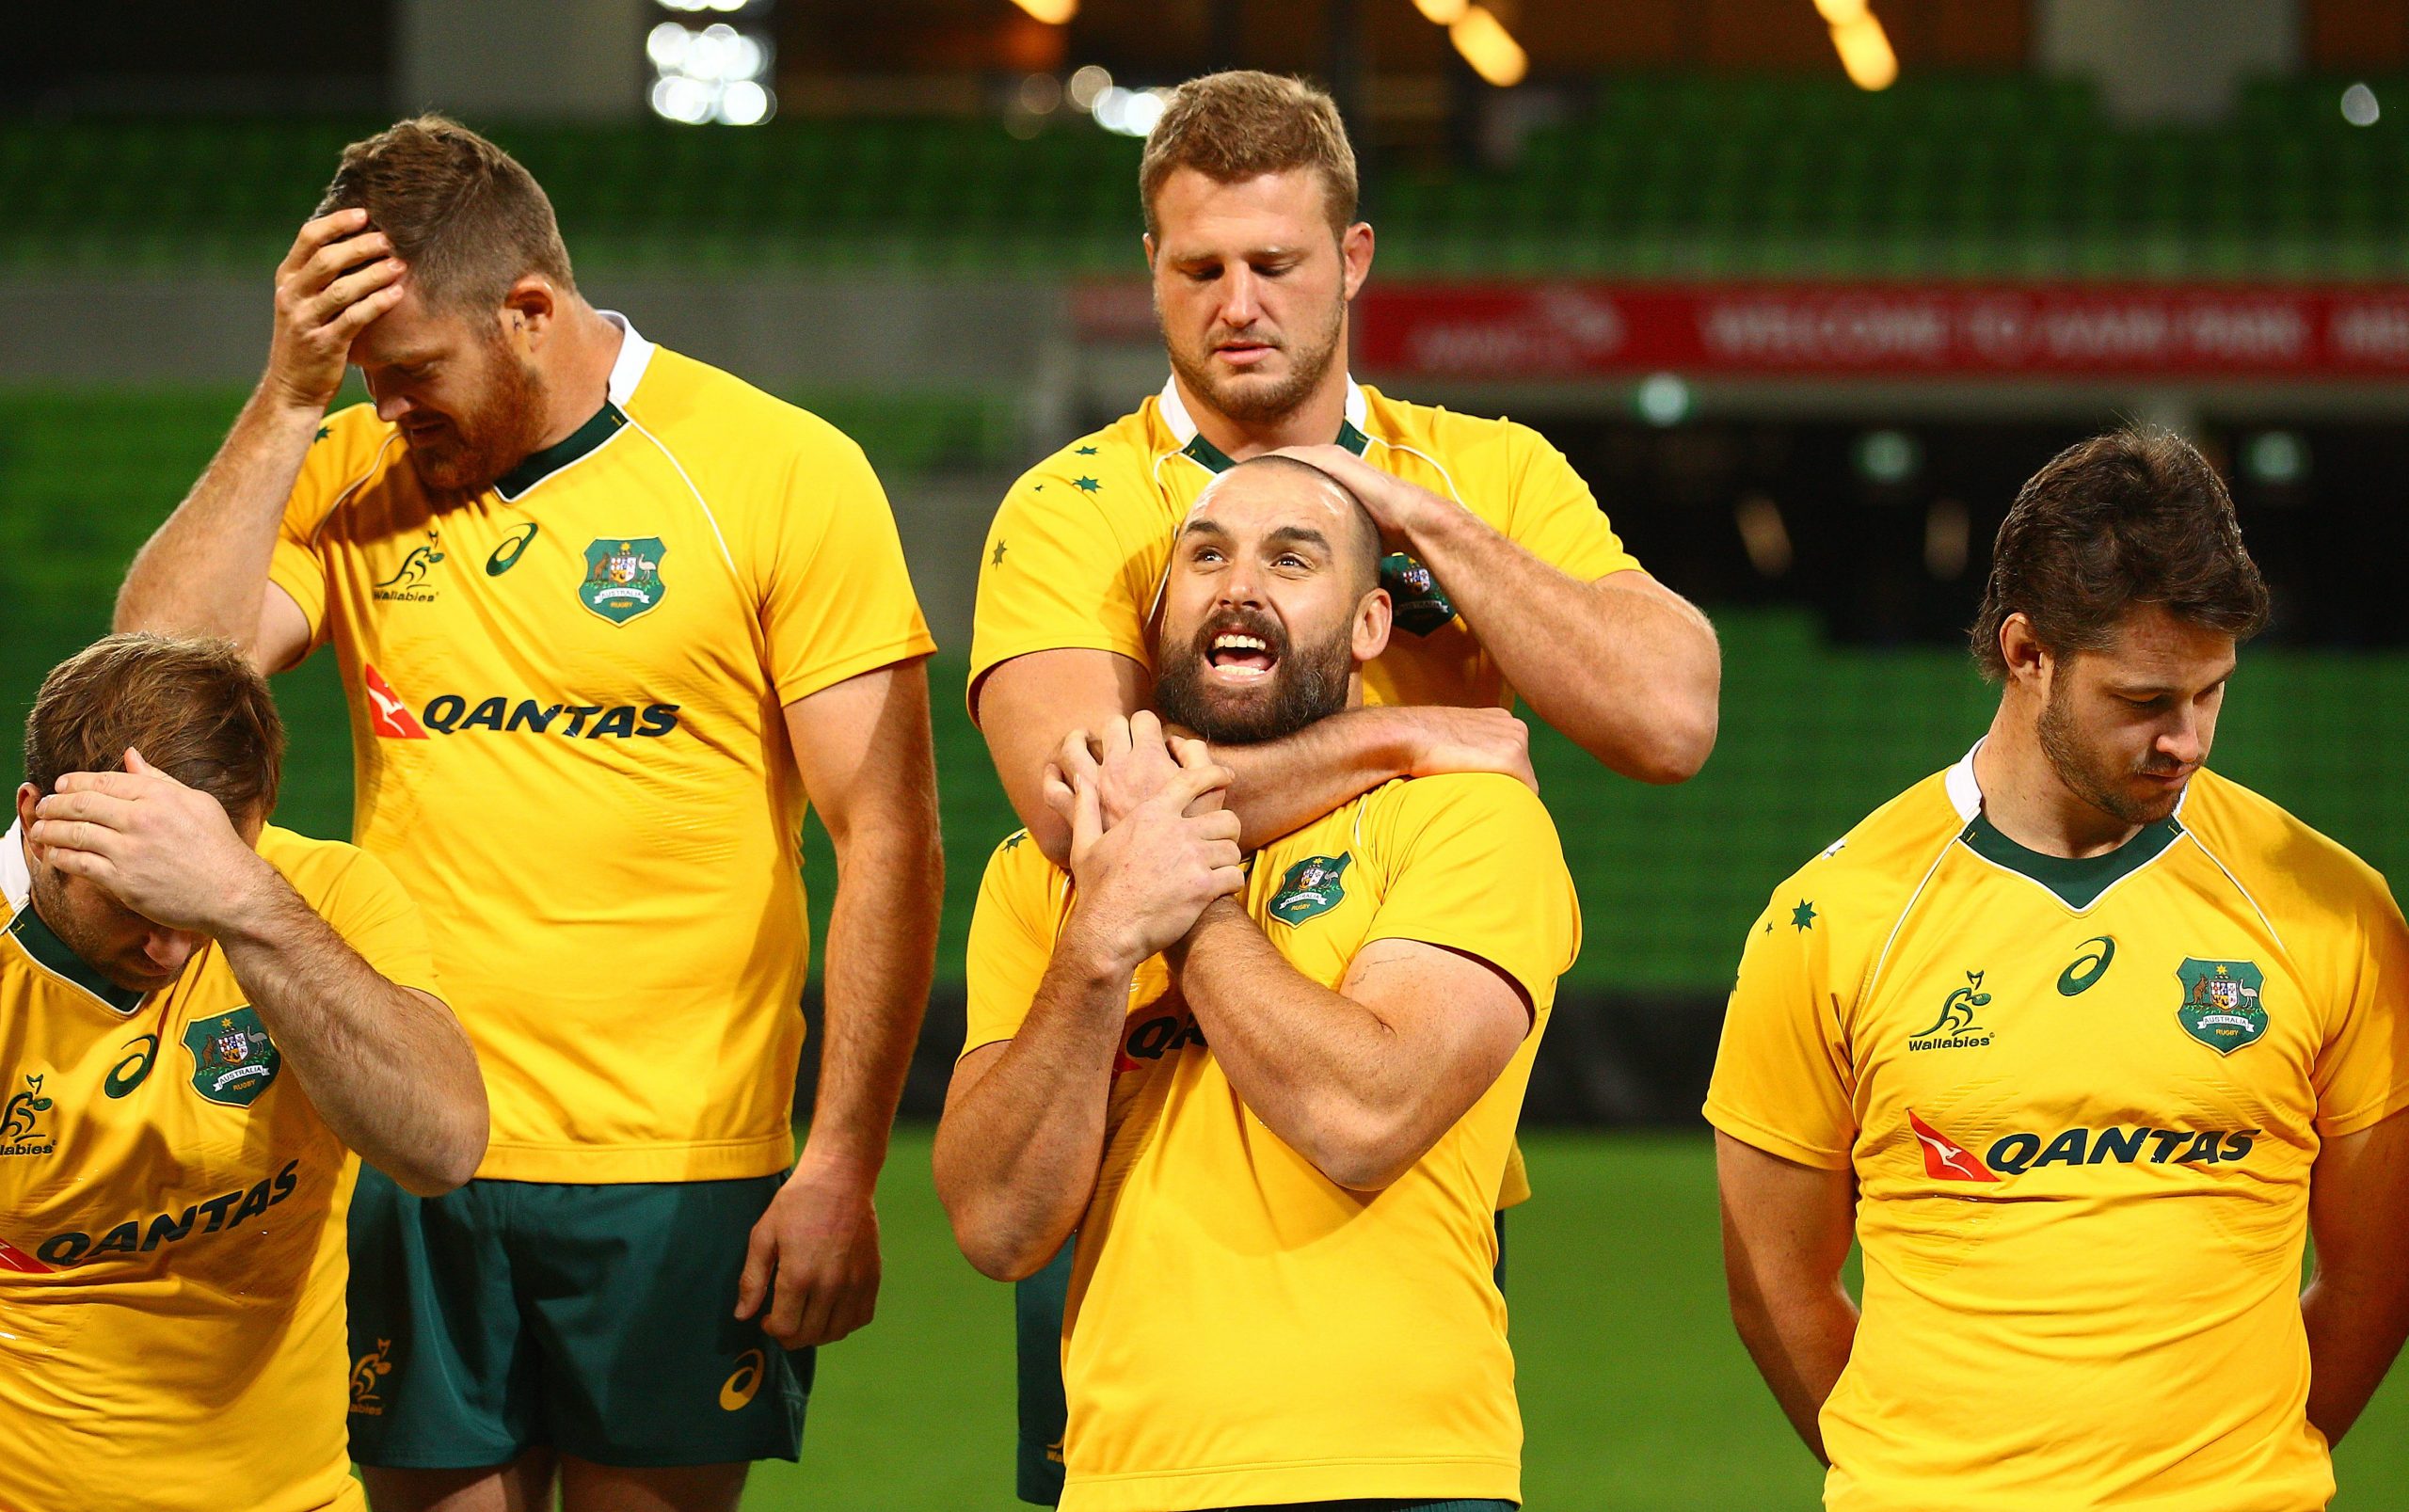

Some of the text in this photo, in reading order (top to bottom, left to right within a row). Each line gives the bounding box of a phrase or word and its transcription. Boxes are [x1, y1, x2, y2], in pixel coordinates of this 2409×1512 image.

[373, 590, 436, 602] Wallabies
[423, 694, 680, 740] QANTAS
[2204, 1016, 2247, 1026] AUSTRALIA
[1908, 1036, 1990, 1052] Wallabies
[218, 1065, 263, 1084] AUSTRALIA
[232, 1078, 256, 1091] RUGBY
[1986, 1126, 2262, 1175] QANTAS
[36, 1158, 299, 1266] QANTAS
